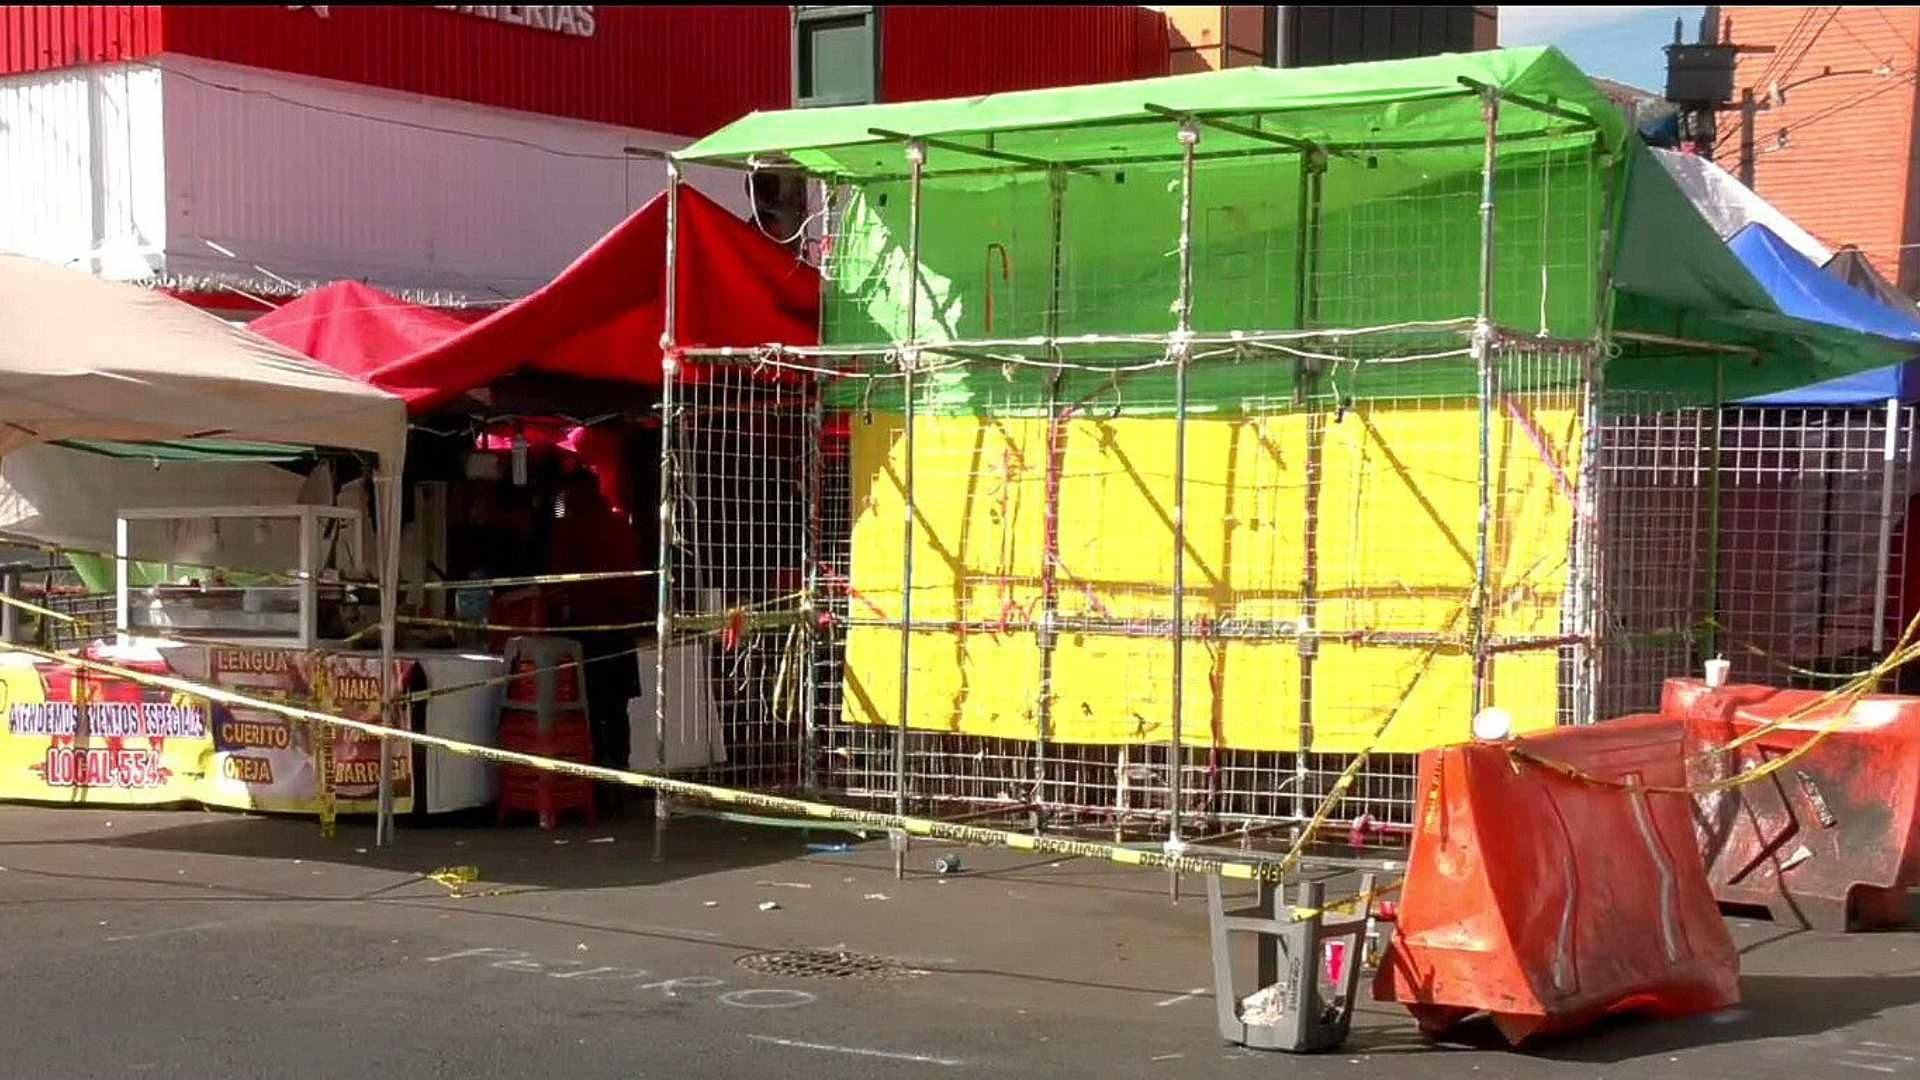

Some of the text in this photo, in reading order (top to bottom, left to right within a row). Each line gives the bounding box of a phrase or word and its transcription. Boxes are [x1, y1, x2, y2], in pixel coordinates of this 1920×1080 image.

[217, 650, 288, 672] LENGUA
[10, 703, 79, 734] ATENDEMOS
[87, 703, 138, 734] EVENTOS
[222, 723, 288, 746] CUERITO
[49, 750, 112, 784] LOCAL
[224, 757, 272, 781] OREJA
